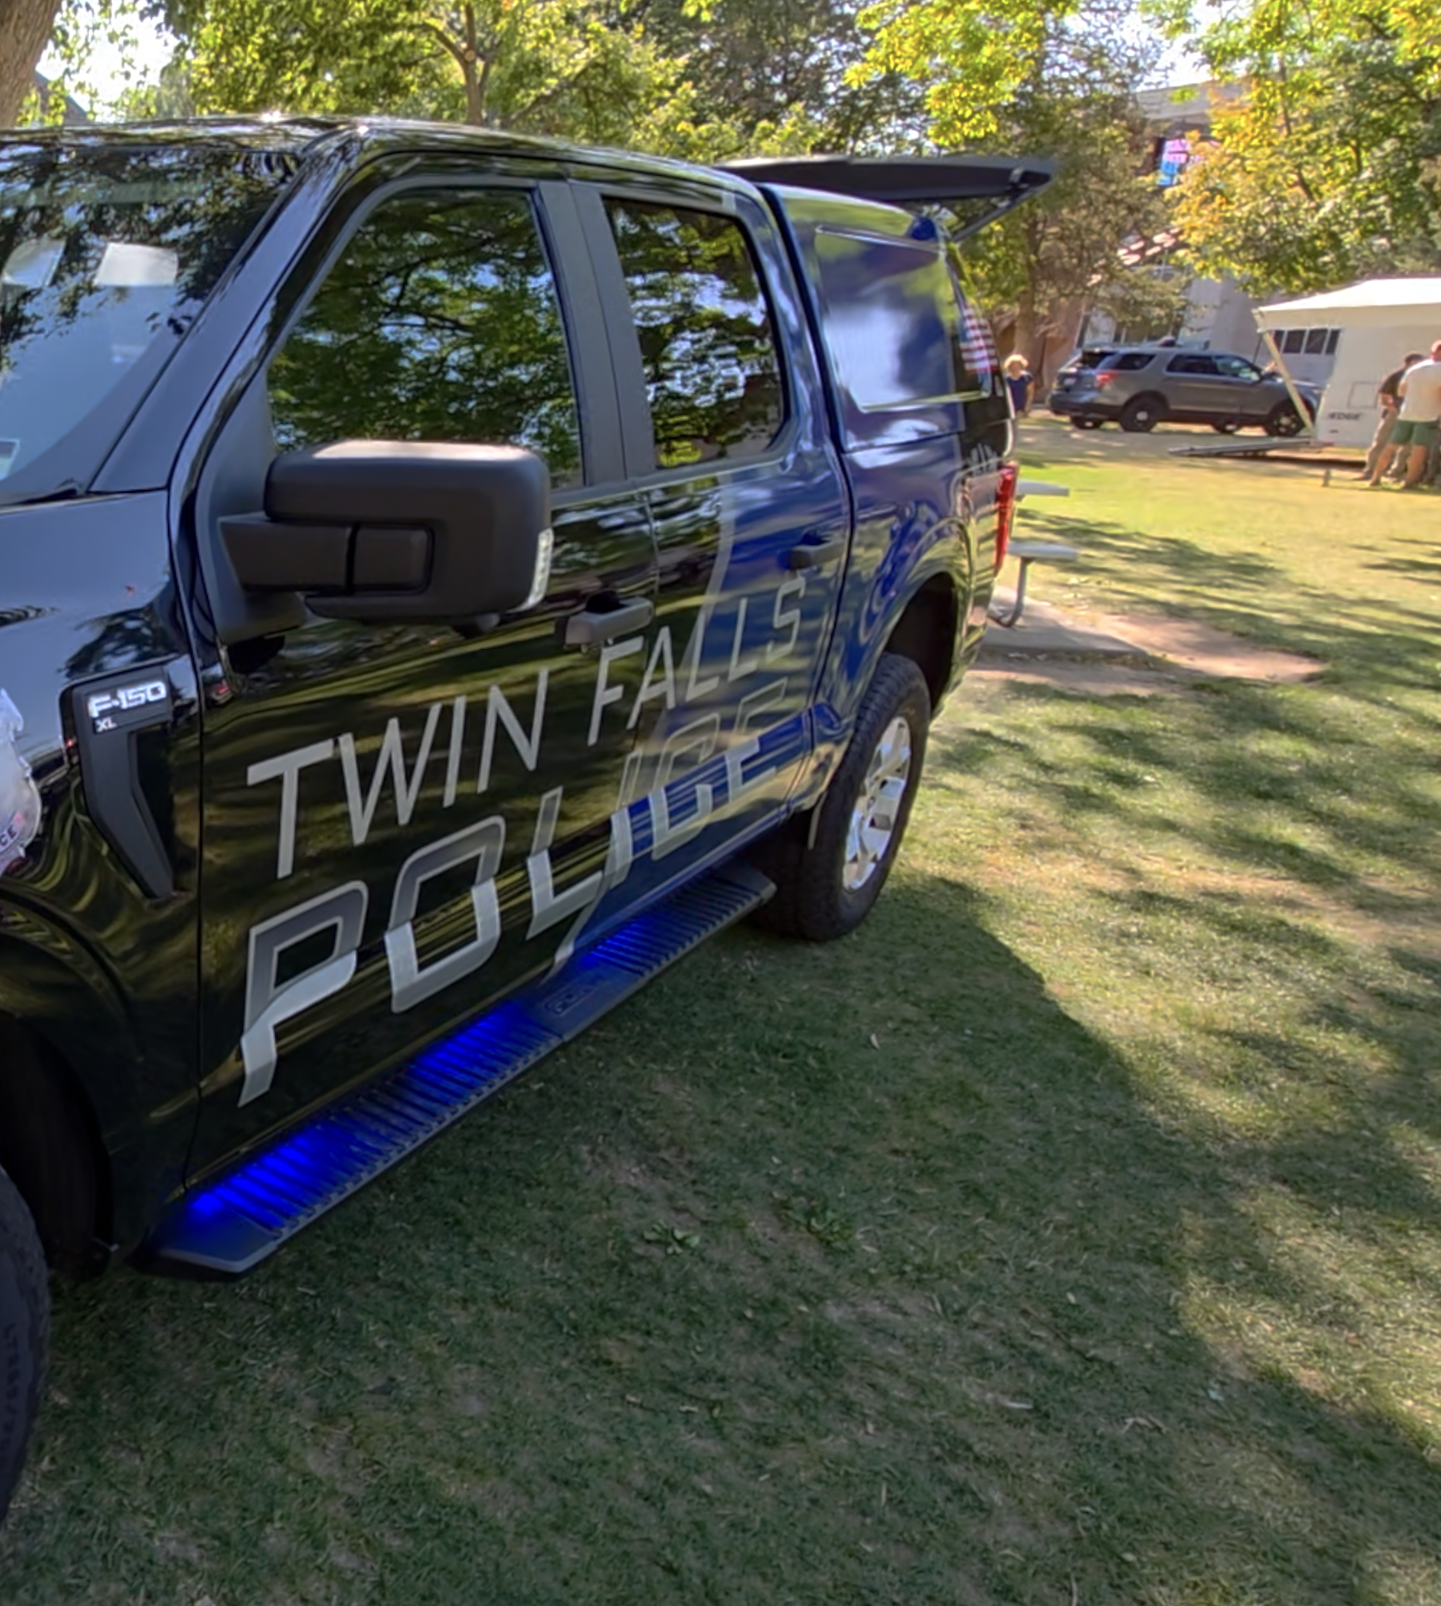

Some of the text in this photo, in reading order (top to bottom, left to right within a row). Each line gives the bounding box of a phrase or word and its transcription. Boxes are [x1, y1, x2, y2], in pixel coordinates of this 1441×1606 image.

[88, 682, 167, 718] F-150
[95, 716, 118, 733] XL
[247, 577, 806, 879] TWIN FALLS
[238, 677, 789, 1107] POLICE
